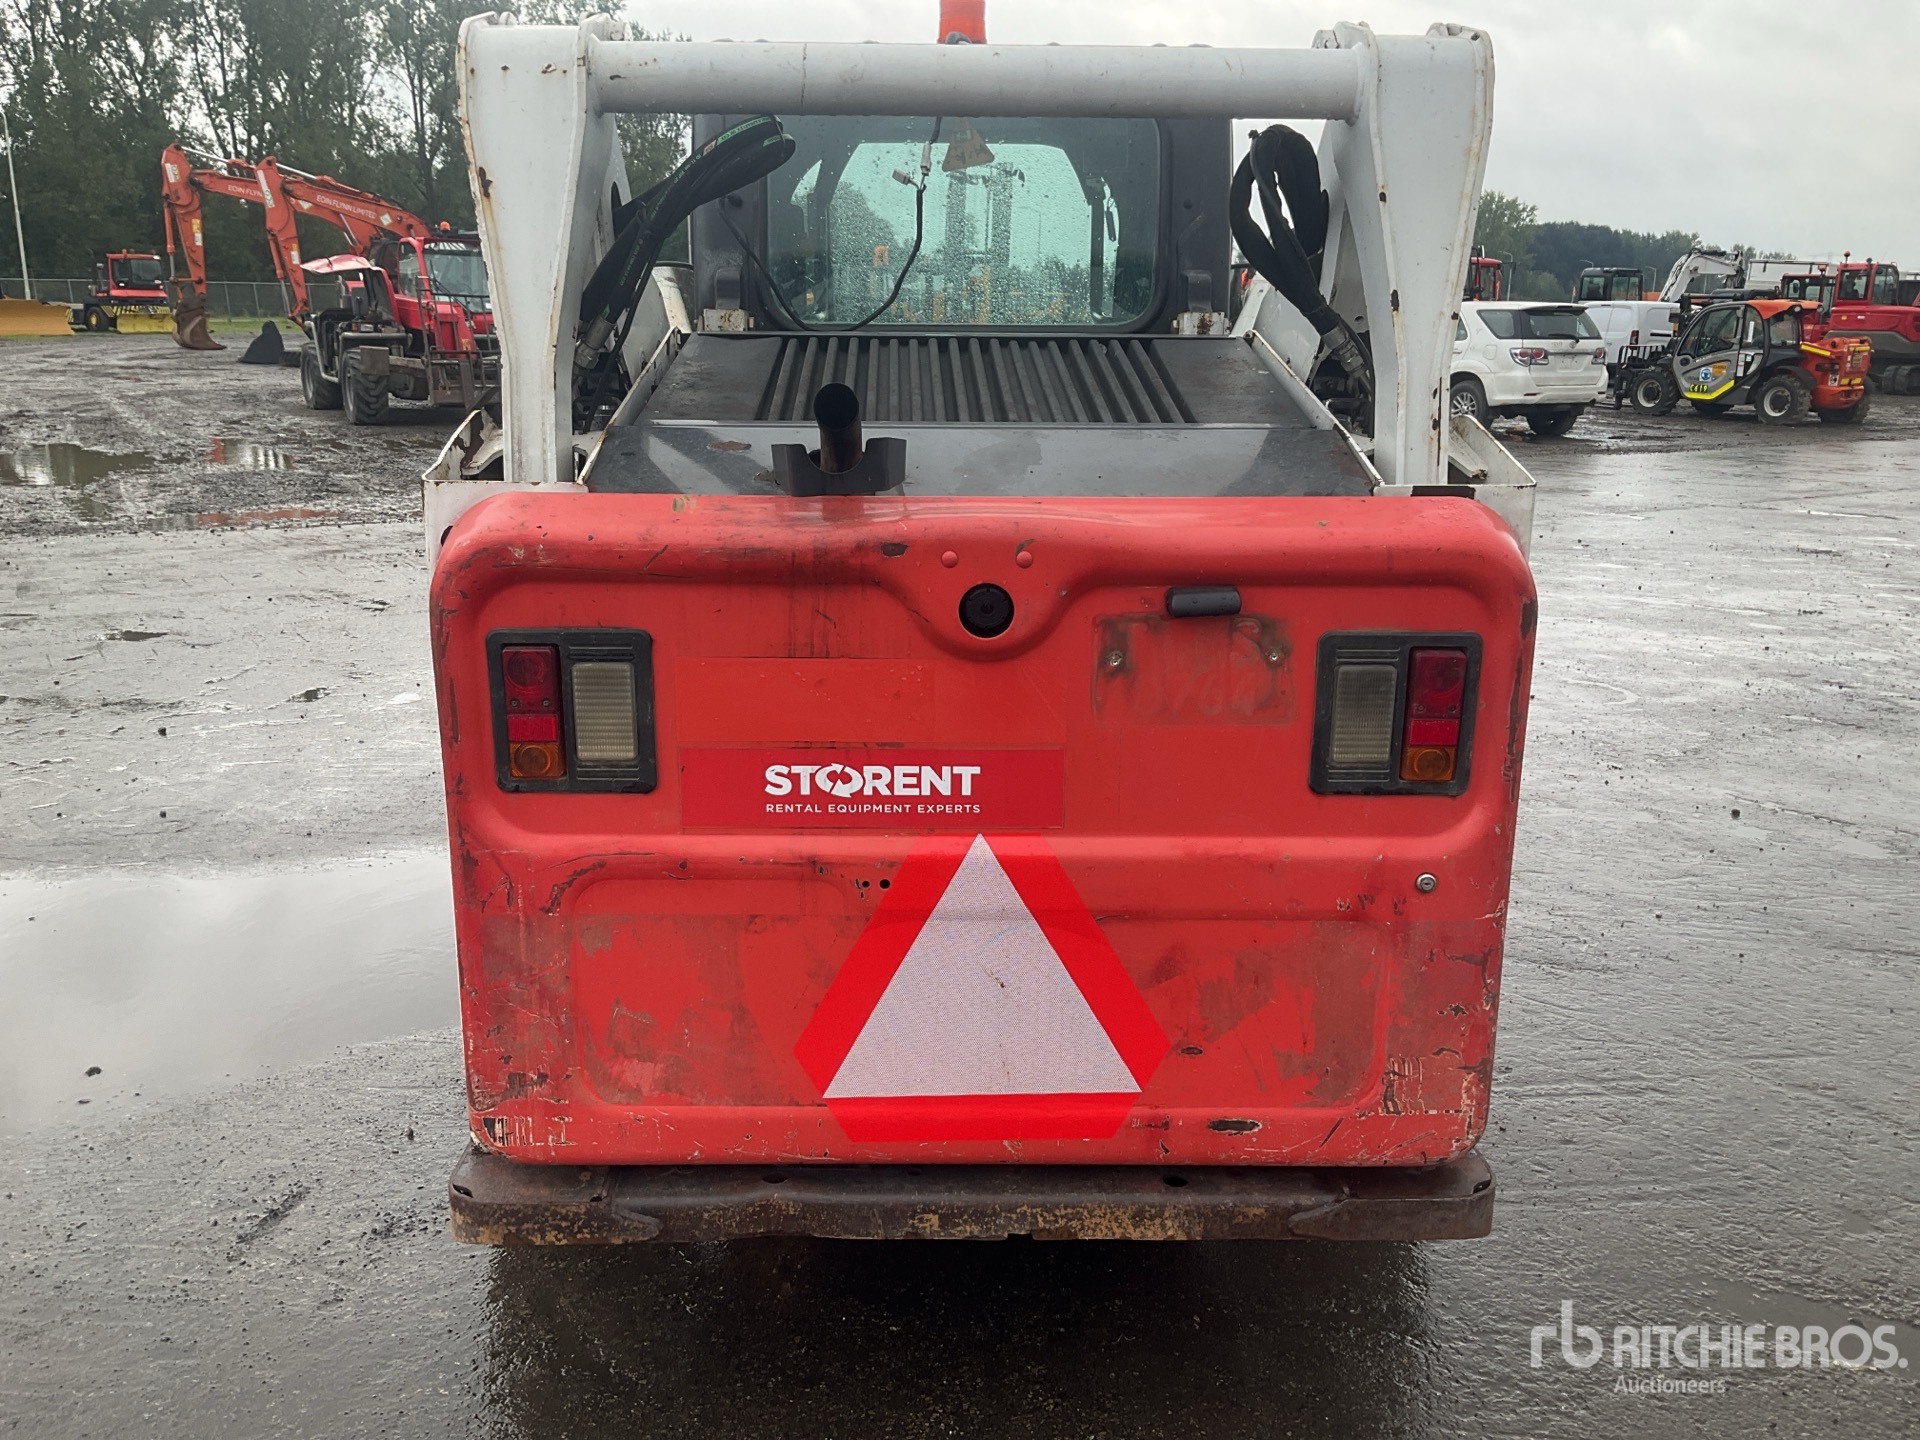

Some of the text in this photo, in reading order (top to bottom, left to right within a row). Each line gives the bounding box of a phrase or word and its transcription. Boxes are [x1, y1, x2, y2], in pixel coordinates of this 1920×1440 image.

[332, 199, 353, 212] FLYNN
[352, 206, 378, 220] LIMITED
[764, 762, 981, 798] STORENT
[765, 803, 981, 814] RENTAL EQUIPMENT EXPERTS
